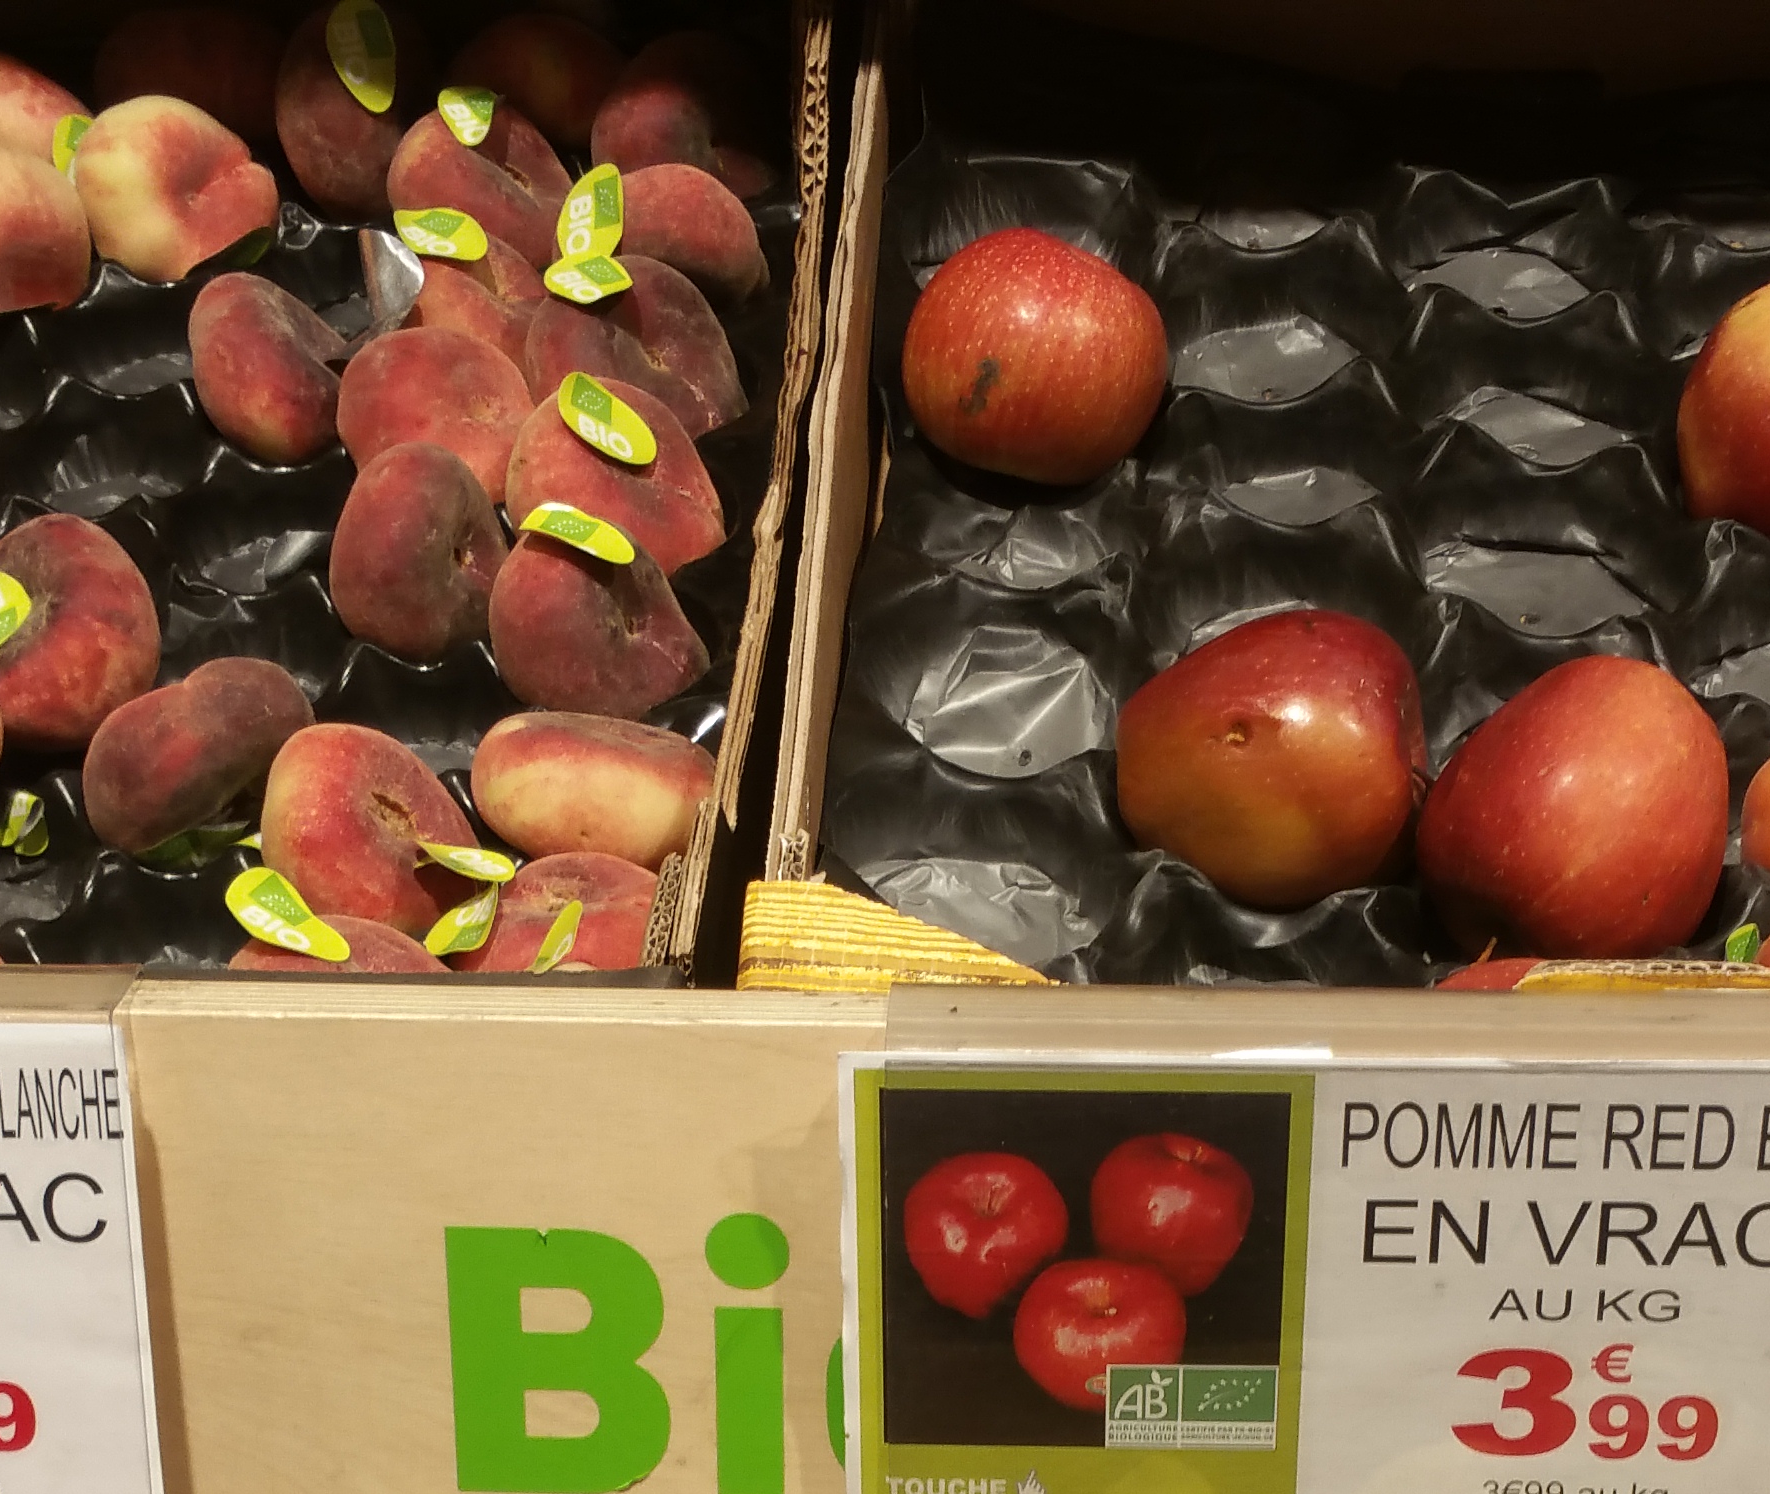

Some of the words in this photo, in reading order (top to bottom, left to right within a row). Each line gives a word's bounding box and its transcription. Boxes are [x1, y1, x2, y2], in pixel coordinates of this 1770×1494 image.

[442, 102, 490, 143] BIO
[400, 223, 457, 257] BIO
[567, 193, 593, 255] BIO
[549, 270, 603, 301] BIO
[577, 413, 634, 459] BIO
[238, 904, 311, 952] BIO
[1340, 1101, 1582, 1170] POMME
[1602, 1103, 1736, 1172] RED
[1361, 1199, 1491, 1265] EN
[1488, 1288, 1573, 1323] AU
[1595, 1289, 1682, 1323] KG
[1114, 1384, 1169, 1419] AB
[1108, 1423, 1178, 1432] AGRICULTURE
[1108, 1432, 1178, 1441] BIOLOGIQUE
